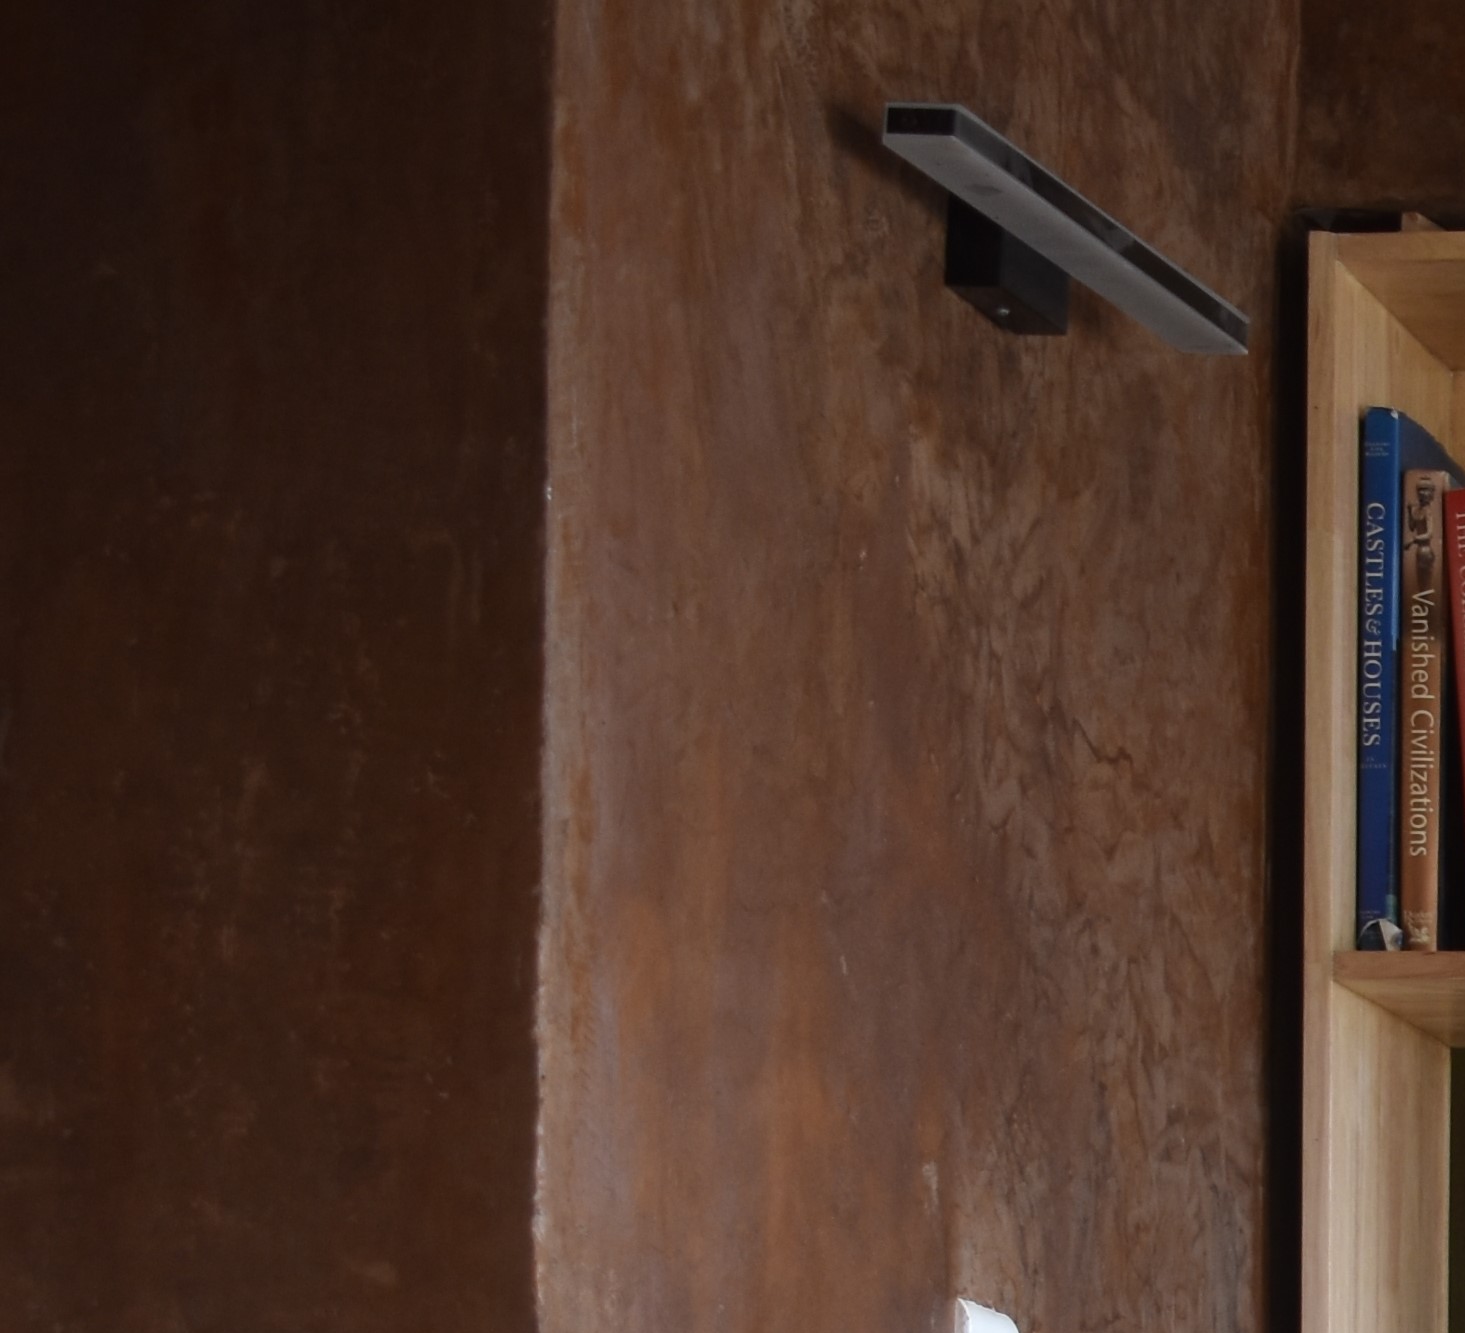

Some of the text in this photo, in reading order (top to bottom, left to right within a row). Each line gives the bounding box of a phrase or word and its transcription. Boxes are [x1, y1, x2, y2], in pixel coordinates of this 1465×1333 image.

[1364, 502, 1385, 615] CASTLES
[1366, 618, 1380, 634] &
[1362, 639, 1381, 746] HOUSES
[1409, 589, 1435, 856] Vanished Civilizations
